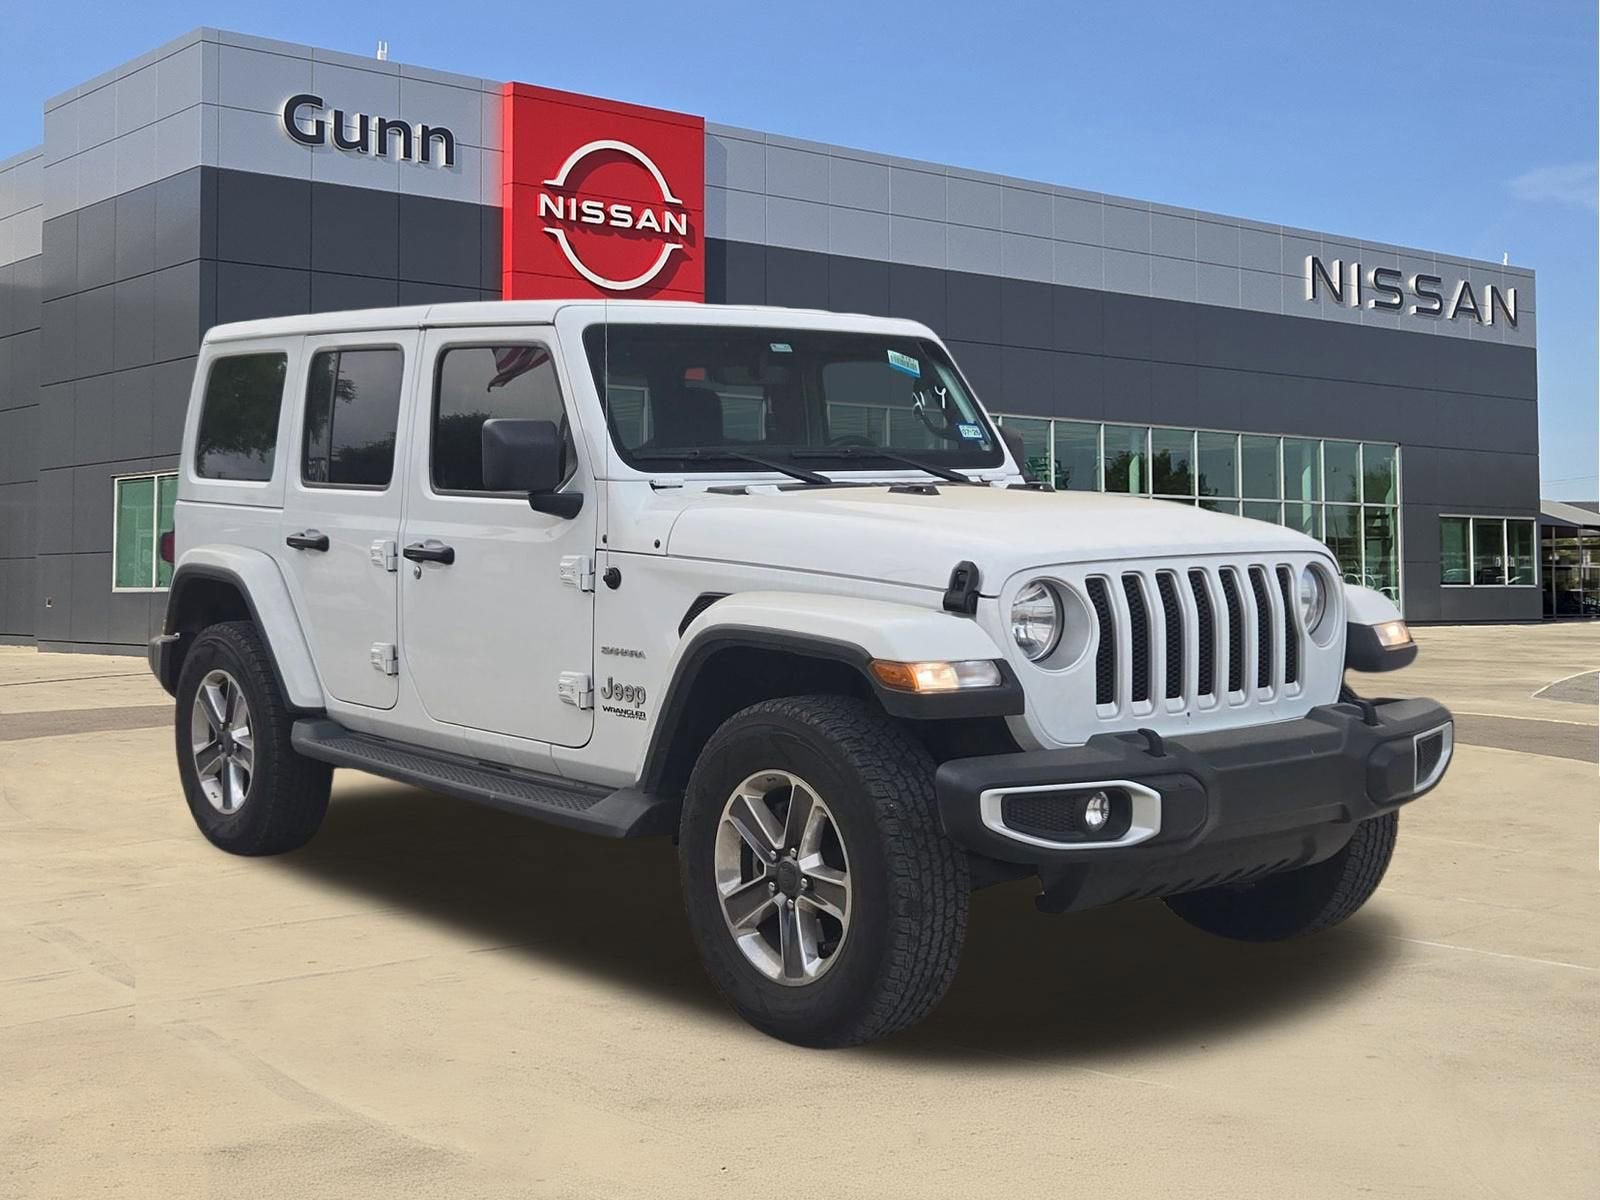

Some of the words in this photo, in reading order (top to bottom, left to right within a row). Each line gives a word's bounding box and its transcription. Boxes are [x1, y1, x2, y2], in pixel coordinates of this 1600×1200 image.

[282, 94, 456, 168] Gunn
[538, 193, 688, 236] NISSAN
[1305, 255, 1518, 327] NISSAN
[601, 676, 646, 708] Jeep
[602, 705, 646, 717] WRANGLER
